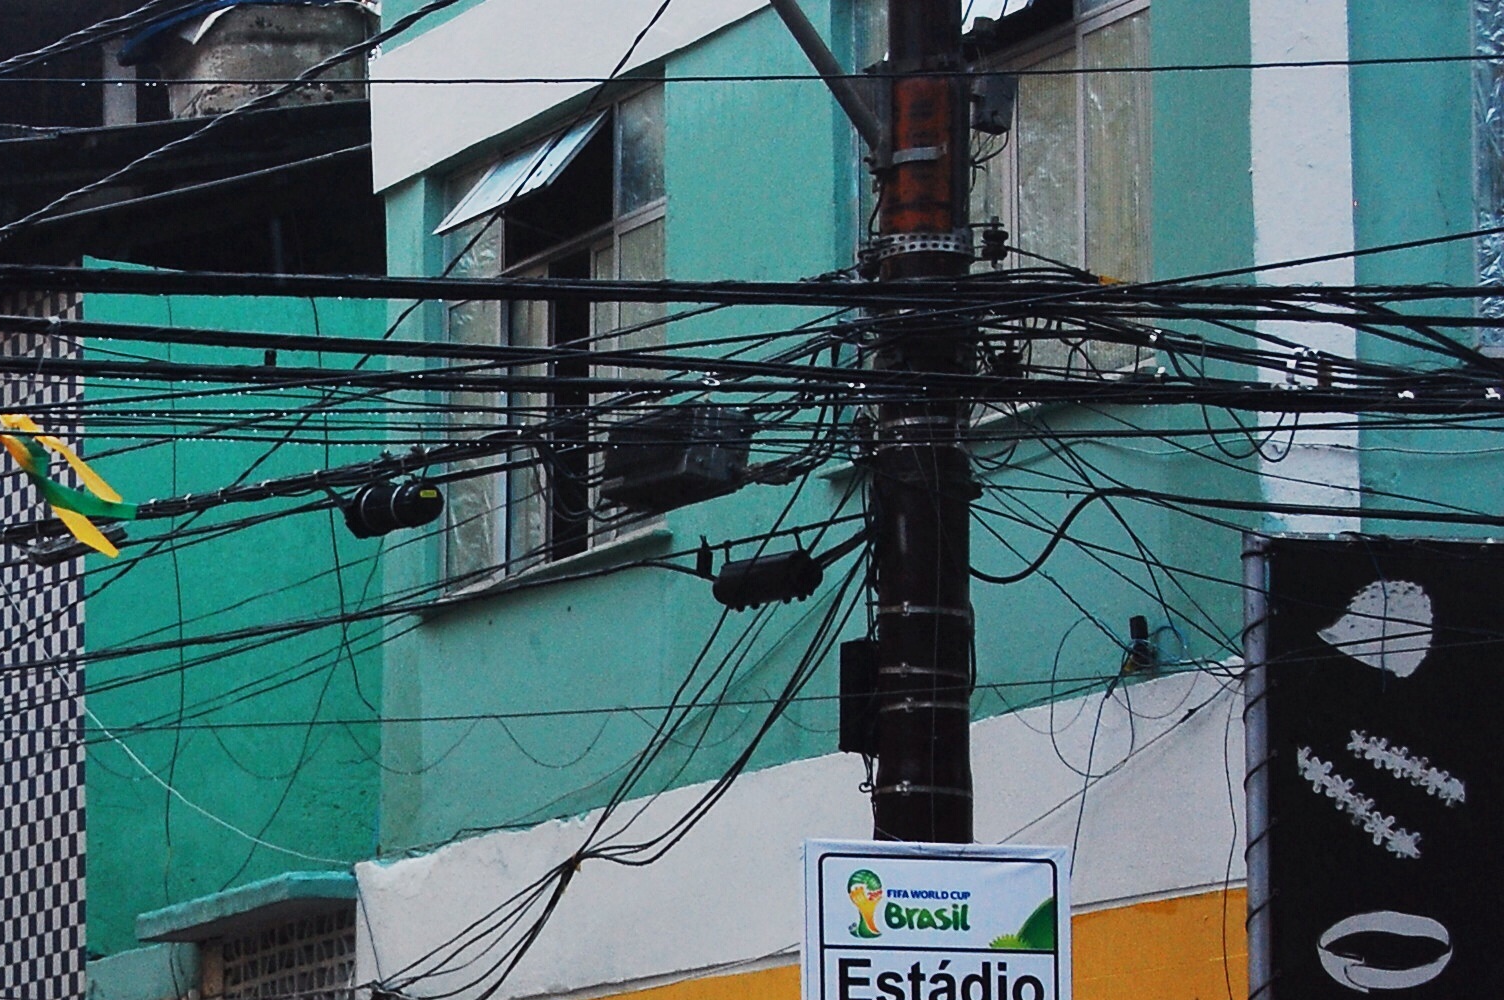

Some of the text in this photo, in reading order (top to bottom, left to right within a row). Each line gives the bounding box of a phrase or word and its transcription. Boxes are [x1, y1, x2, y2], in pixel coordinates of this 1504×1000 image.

[887, 889, 909, 899] FIFA
[911, 890, 949, 900] WORLD
[950, 891, 971, 901] CUP
[884, 902, 971, 932] Brasil
